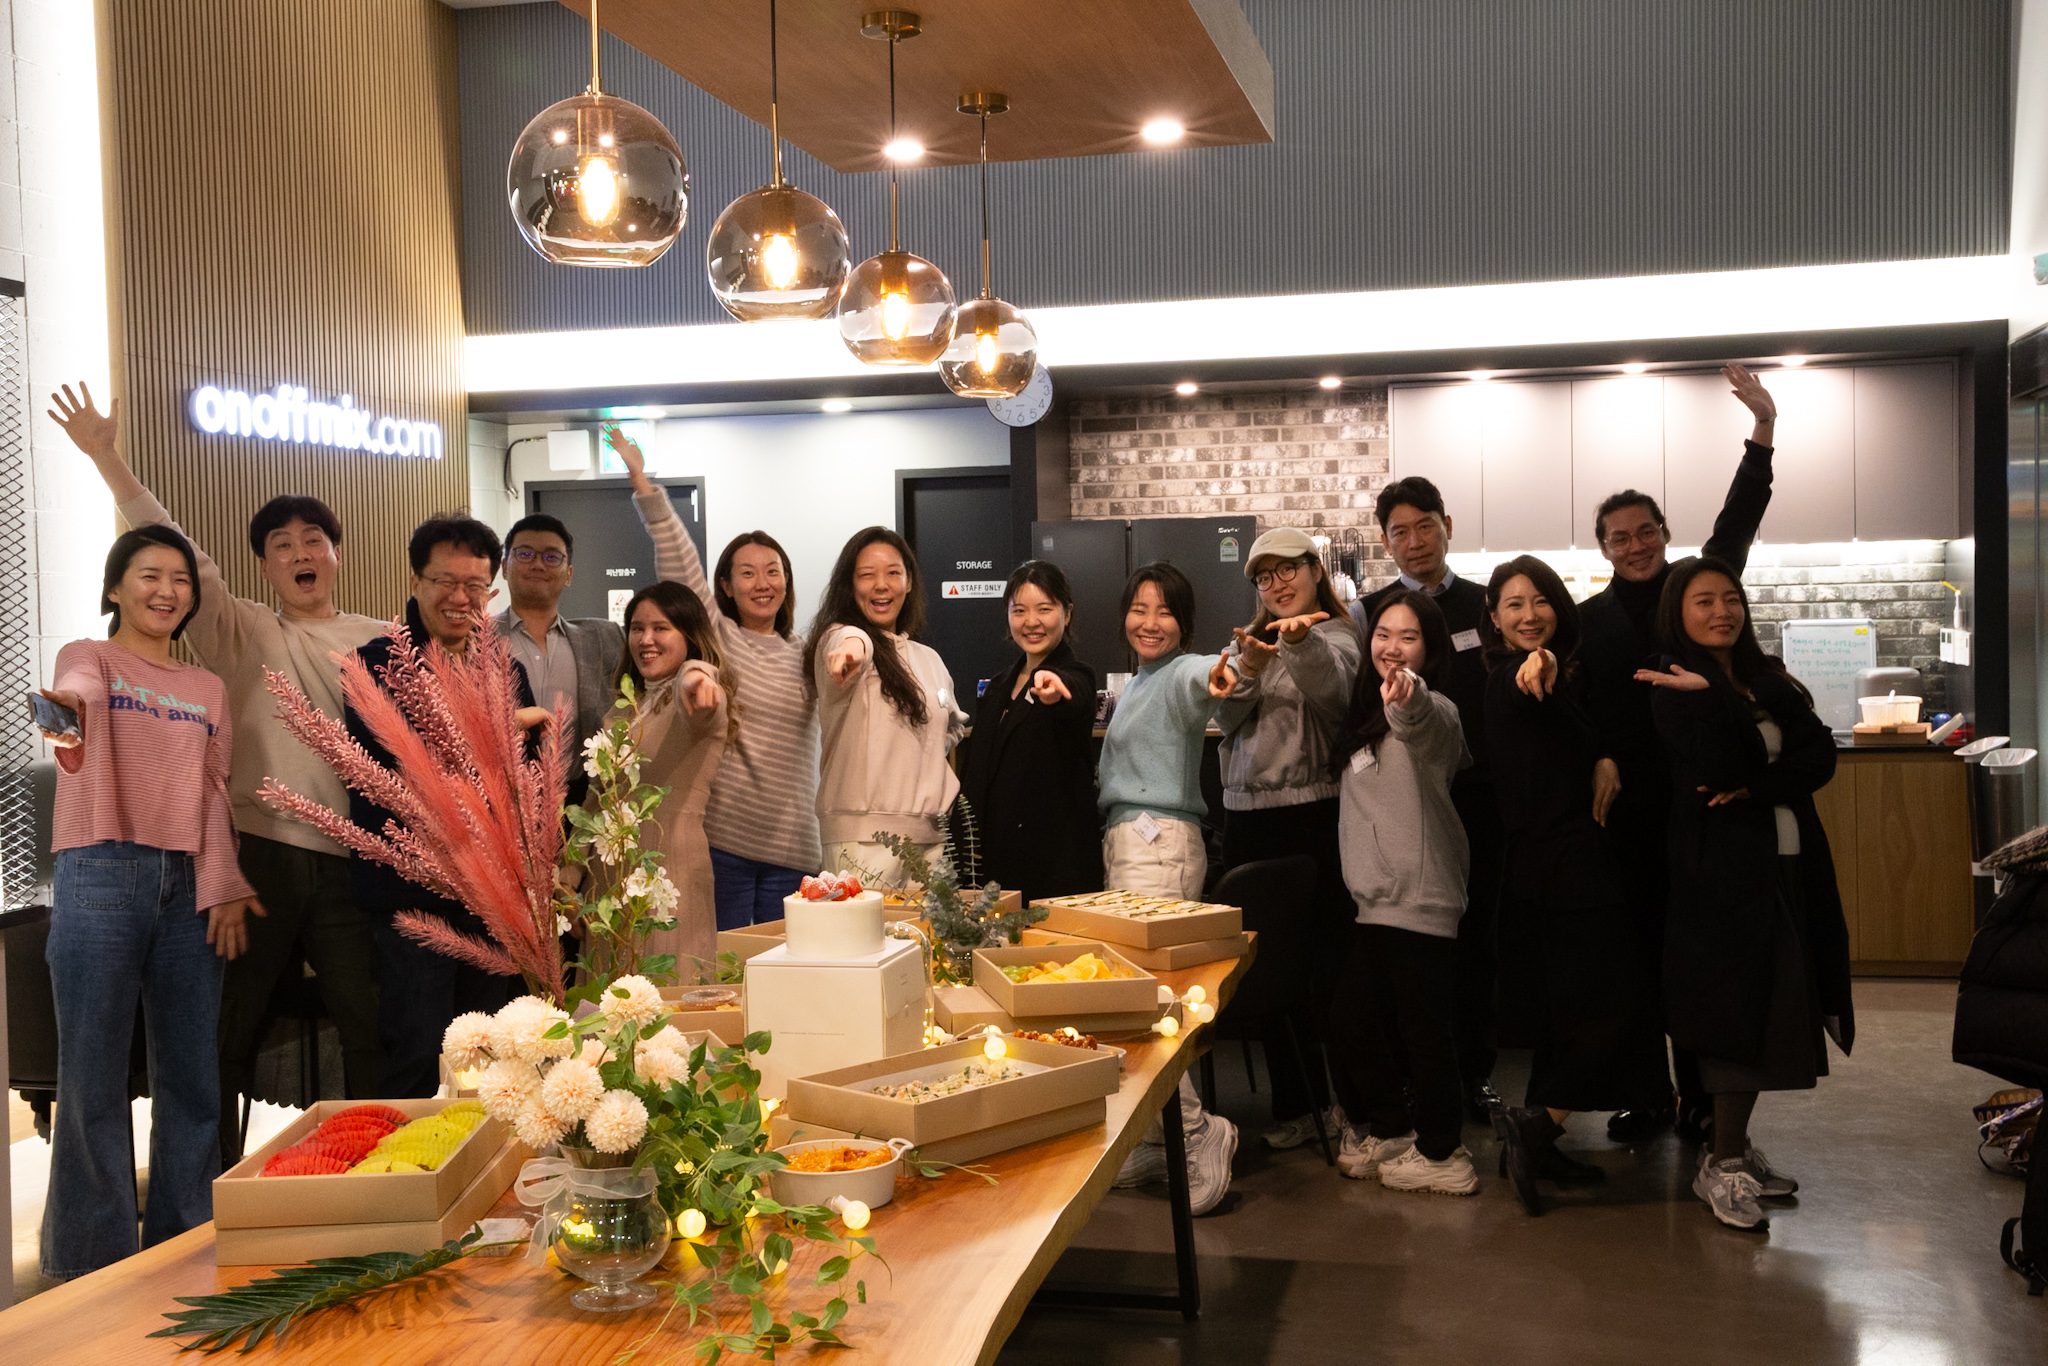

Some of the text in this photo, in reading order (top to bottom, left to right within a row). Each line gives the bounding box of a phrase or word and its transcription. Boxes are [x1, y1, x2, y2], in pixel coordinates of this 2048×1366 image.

[1037, 372, 1046, 383] 2
[1043, 385, 1050, 396] 3
[995, 400, 1002, 412] 8
[1038, 398, 1045, 409] 4
[1005, 409, 1012, 420] 7
[1017, 412, 1025, 423] 6
[1030, 408, 1037, 419] 5
[193, 383, 442, 460] onoffmix.com
[956, 560, 992, 569] STORAGE
